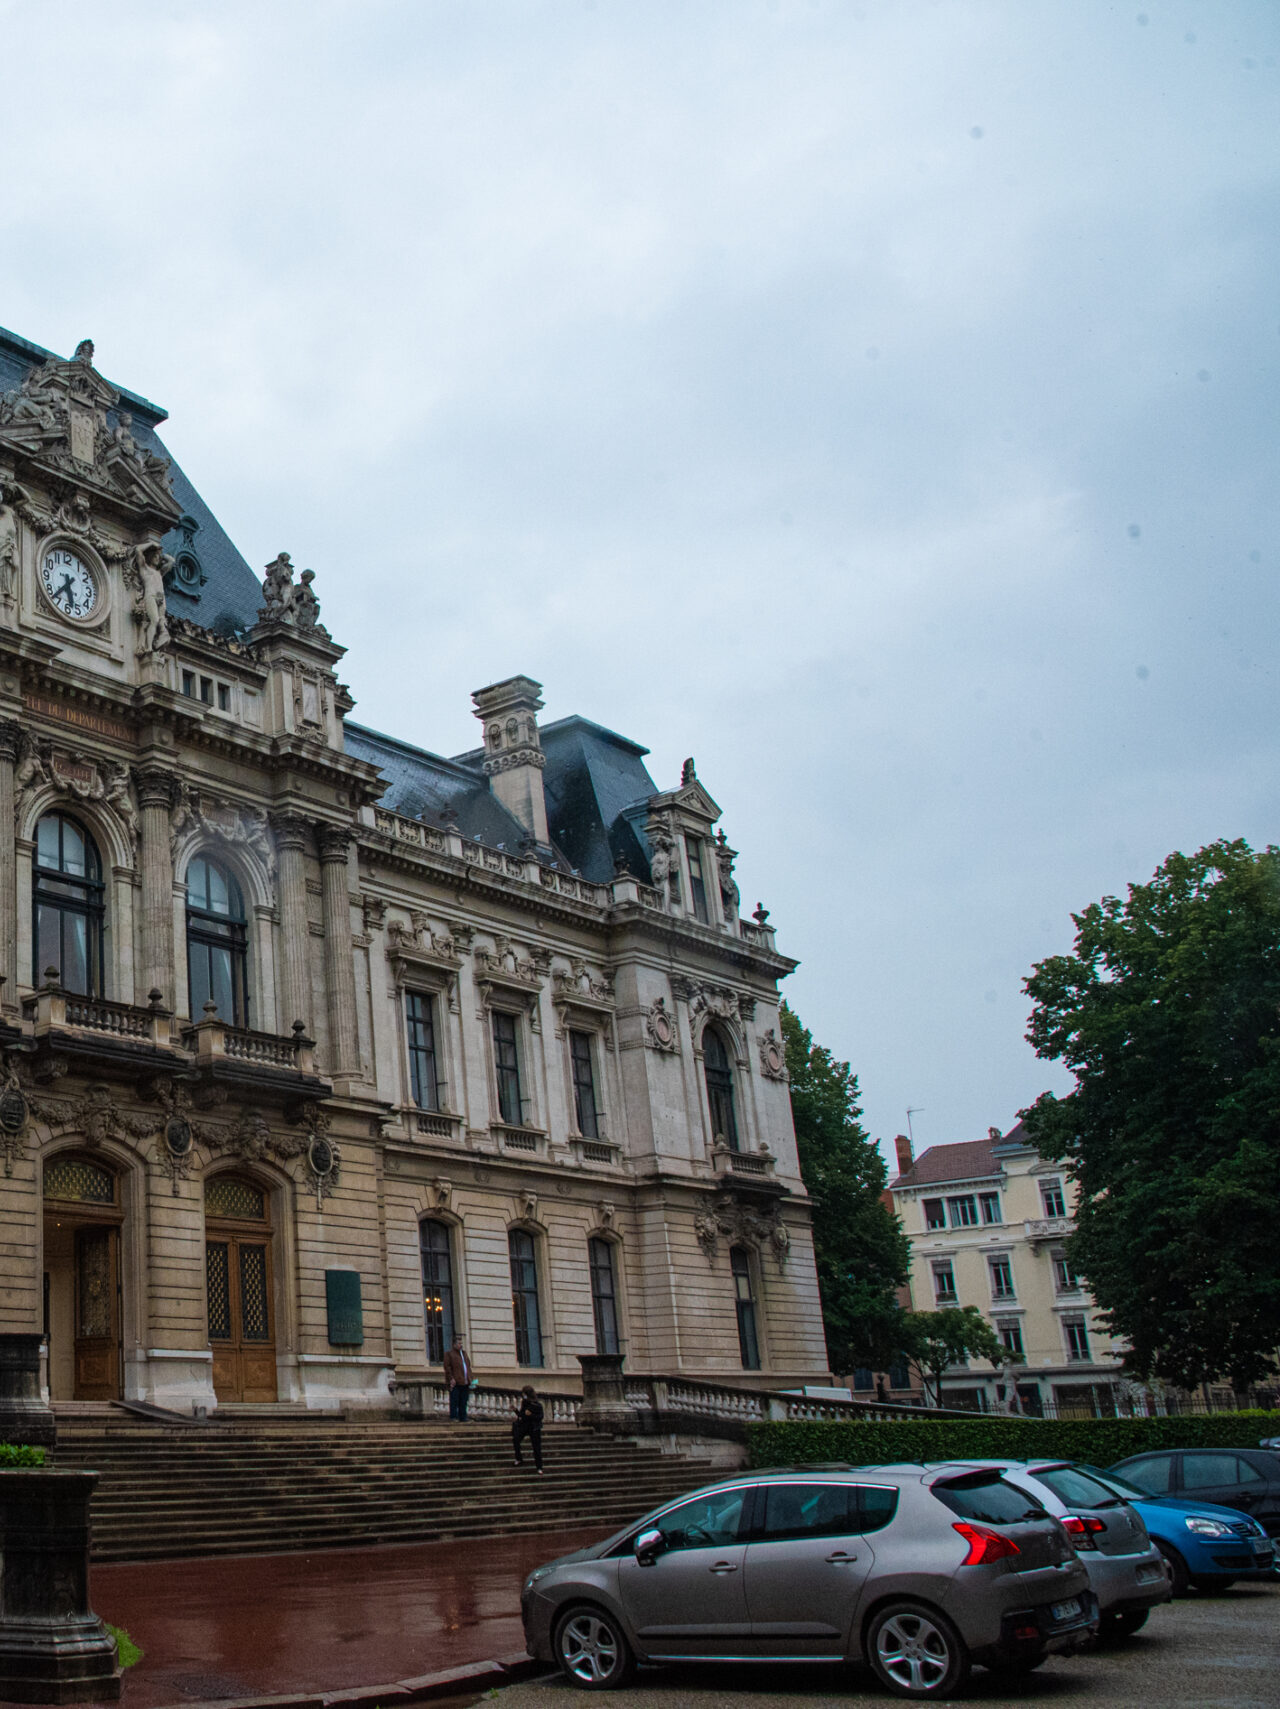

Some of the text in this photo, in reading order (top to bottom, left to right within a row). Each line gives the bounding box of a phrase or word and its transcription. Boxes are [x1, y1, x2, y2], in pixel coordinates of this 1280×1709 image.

[46, 557, 53, 570] 10
[55, 552, 60, 564] 11
[63, 552, 72, 566] 12
[77, 561, 80, 573] 1
[43, 569, 50, 581] 9
[82, 572, 89, 584] 2
[46, 583, 53, 595] 8
[85, 586, 92, 598] 3
[55, 596, 61, 606] 7
[82, 598, 89, 610] 4
[64, 603, 71, 615] 6
[74, 603, 81, 616] 5
